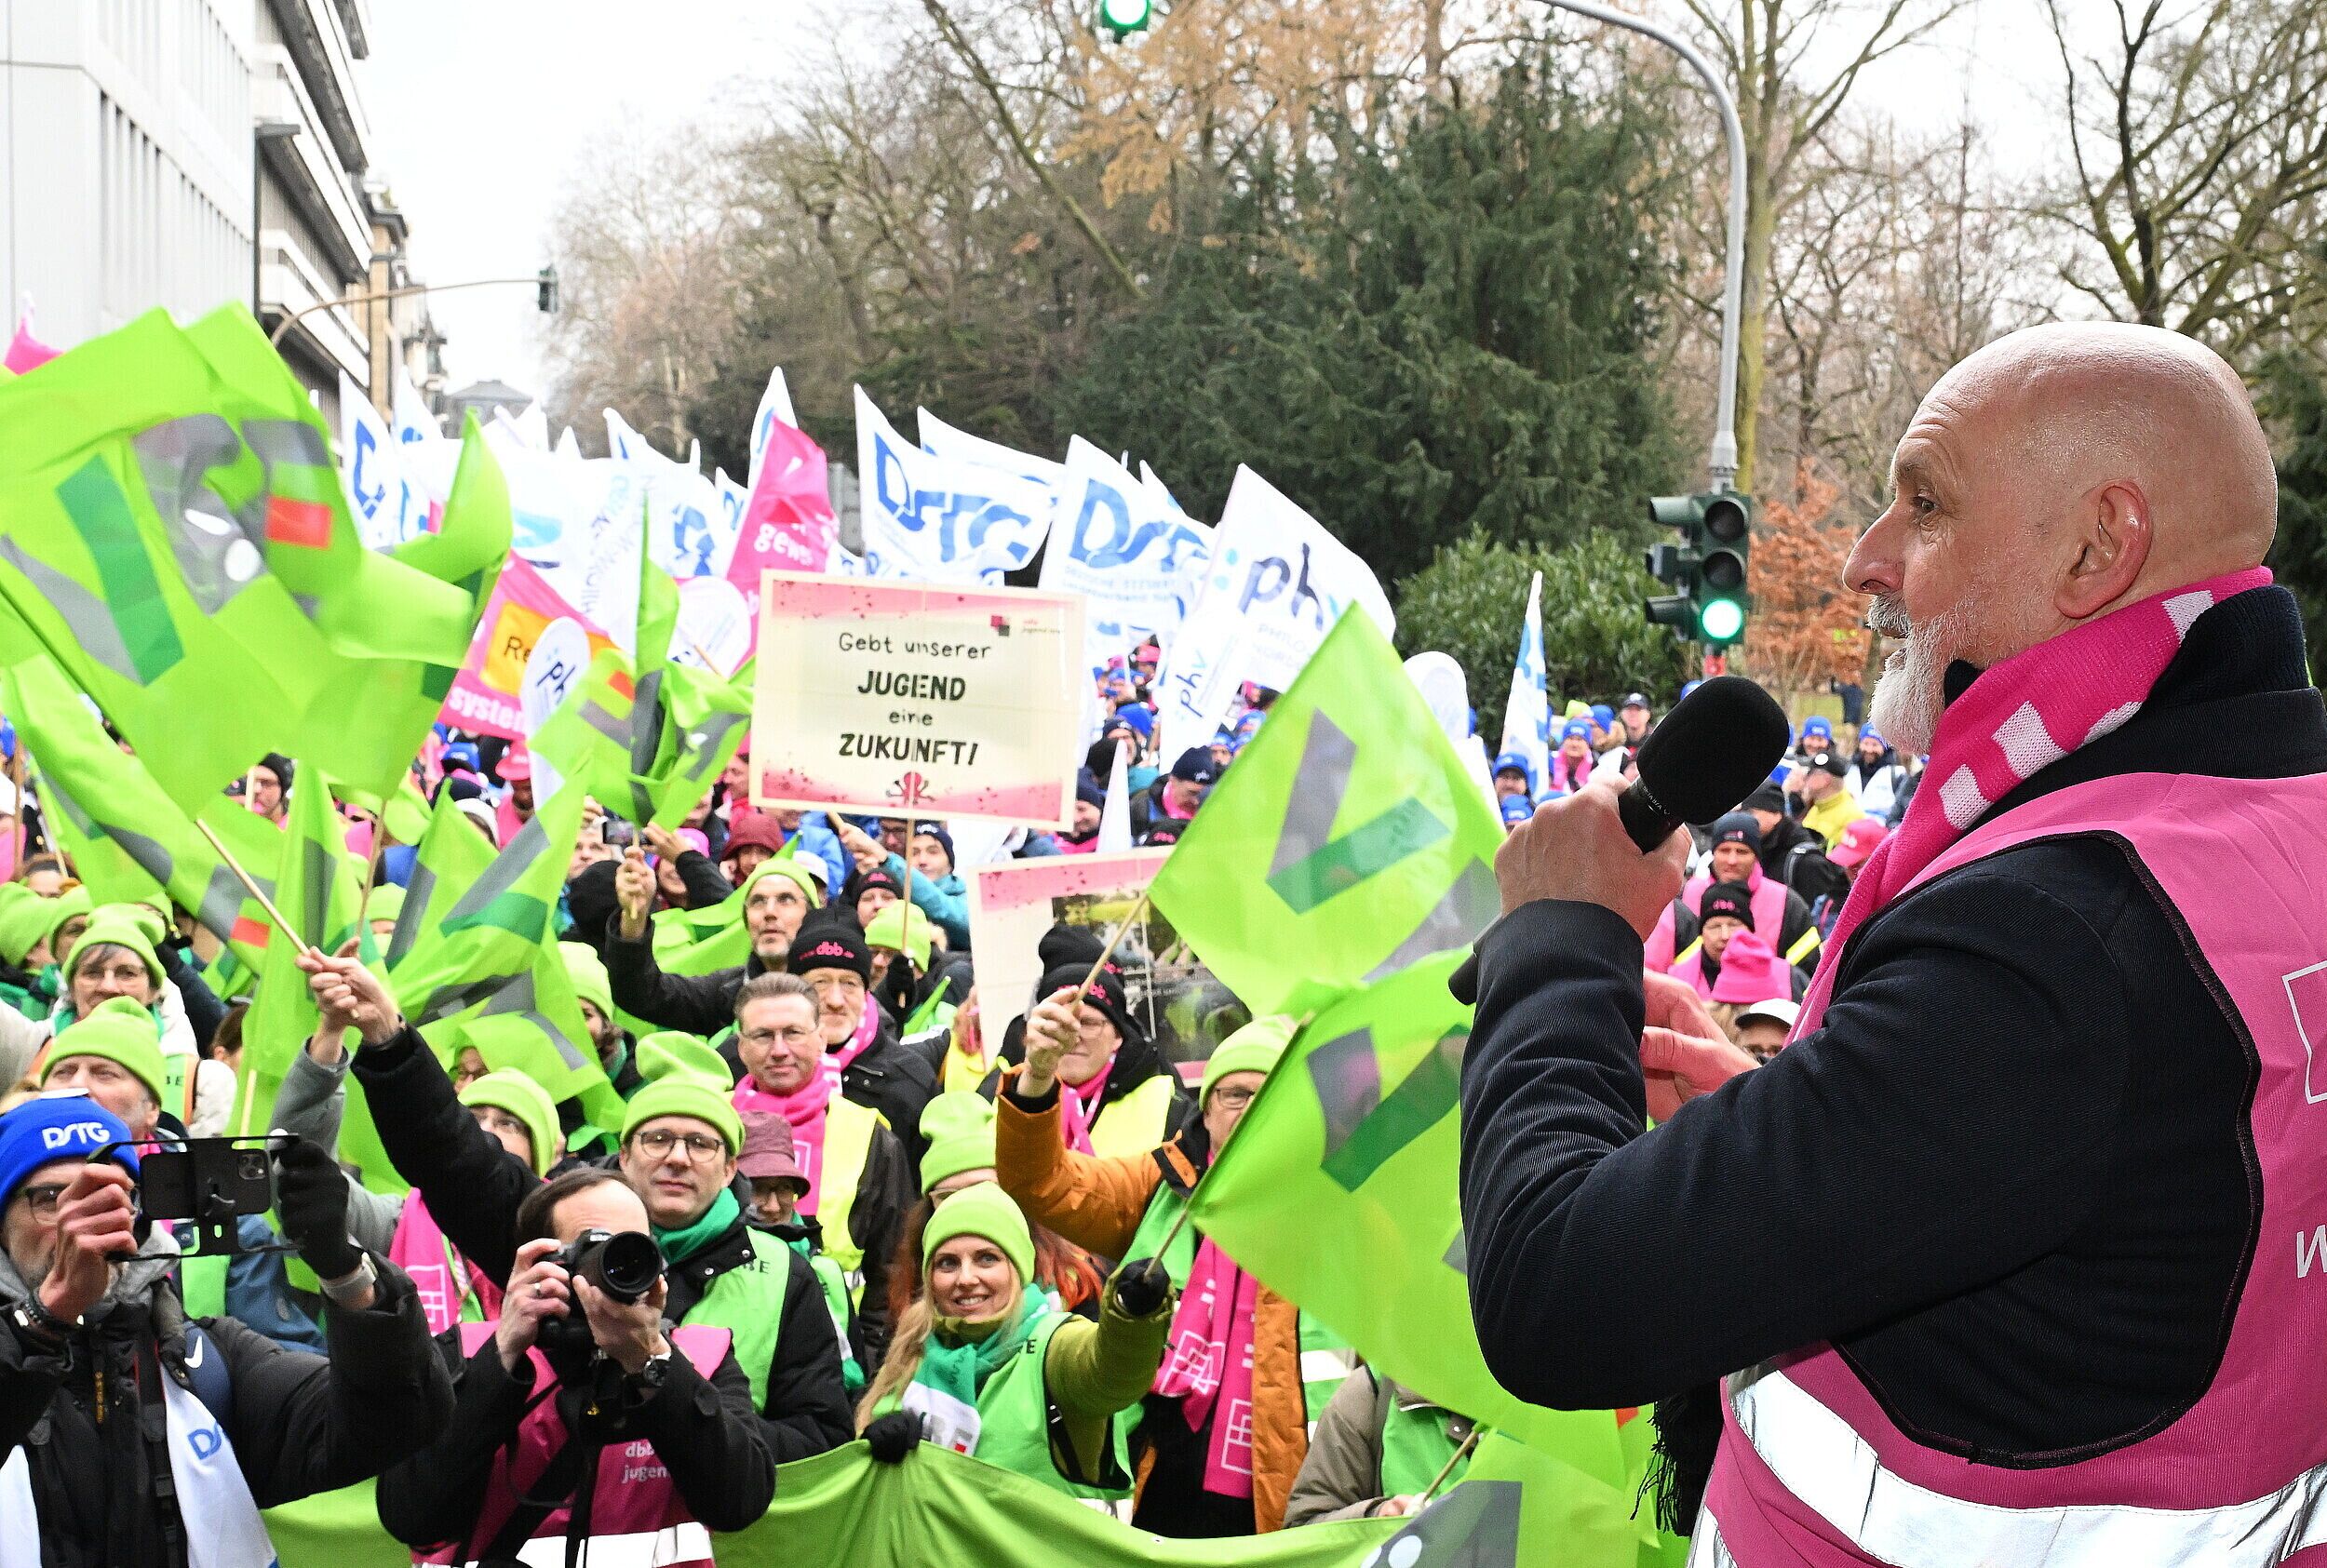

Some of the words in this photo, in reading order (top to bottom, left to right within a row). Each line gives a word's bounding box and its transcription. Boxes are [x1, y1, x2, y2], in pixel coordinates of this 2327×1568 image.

[839, 632, 894, 654] Gebt
[905, 641, 992, 660] unserer
[857, 670, 966, 702] JUGEND
[888, 710, 934, 727] eine
[839, 733, 979, 766] ZUKUNFT!
[41, 1121, 111, 1150] DSTG
[621, 1464, 670, 1484] jugen
